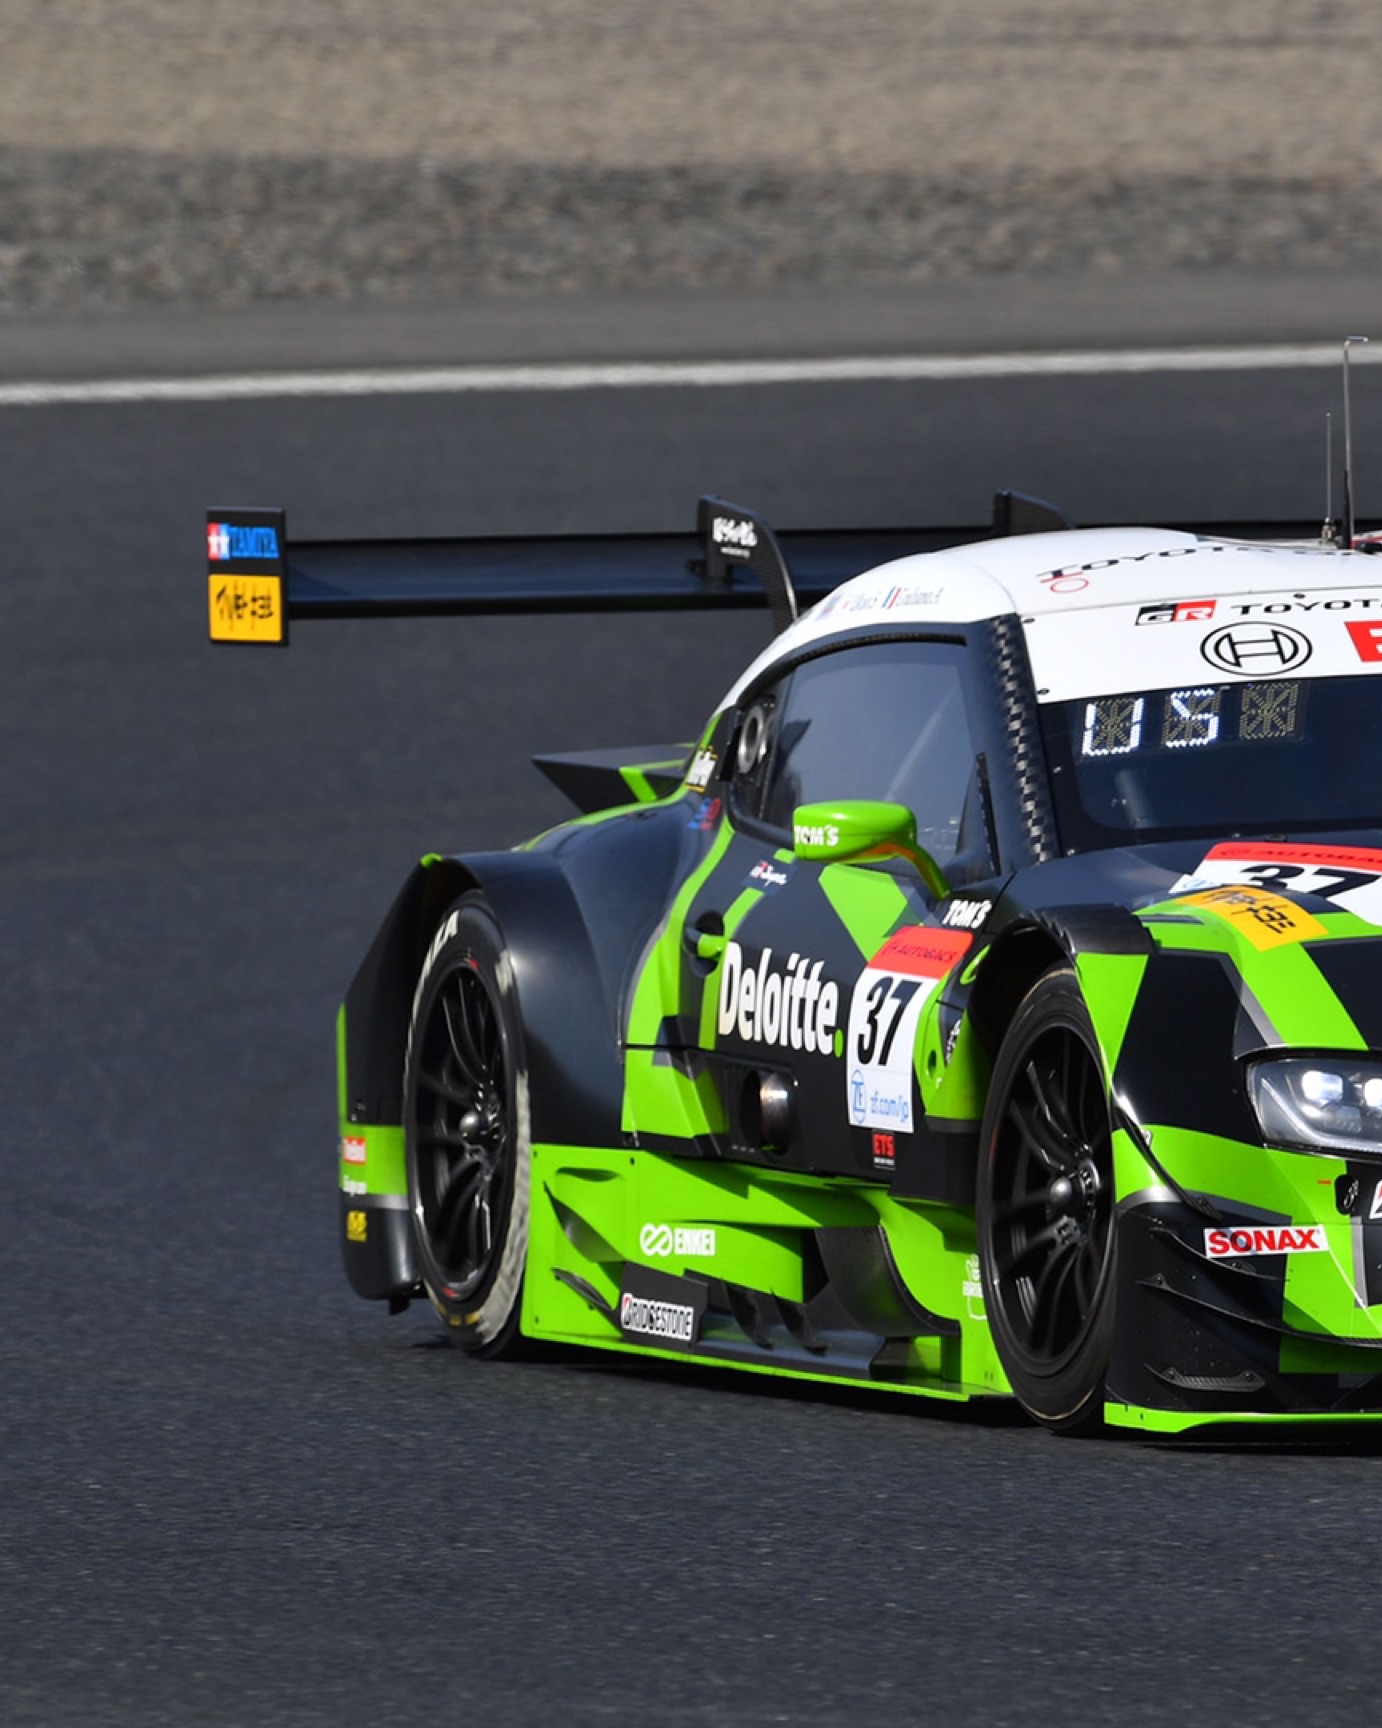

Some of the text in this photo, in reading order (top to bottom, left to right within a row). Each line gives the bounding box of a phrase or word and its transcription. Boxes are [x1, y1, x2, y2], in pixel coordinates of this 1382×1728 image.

[793, 824, 840, 847] TOM'S
[1239, 864, 1382, 901] 37
[941, 899, 993, 929] TOM'S
[857, 976, 923, 1067] 37
[674, 1228, 716, 1256] ENKEI
[1208, 1229, 1321, 1255] SONAX
[623, 1295, 694, 1339] BRIDGESTONE
